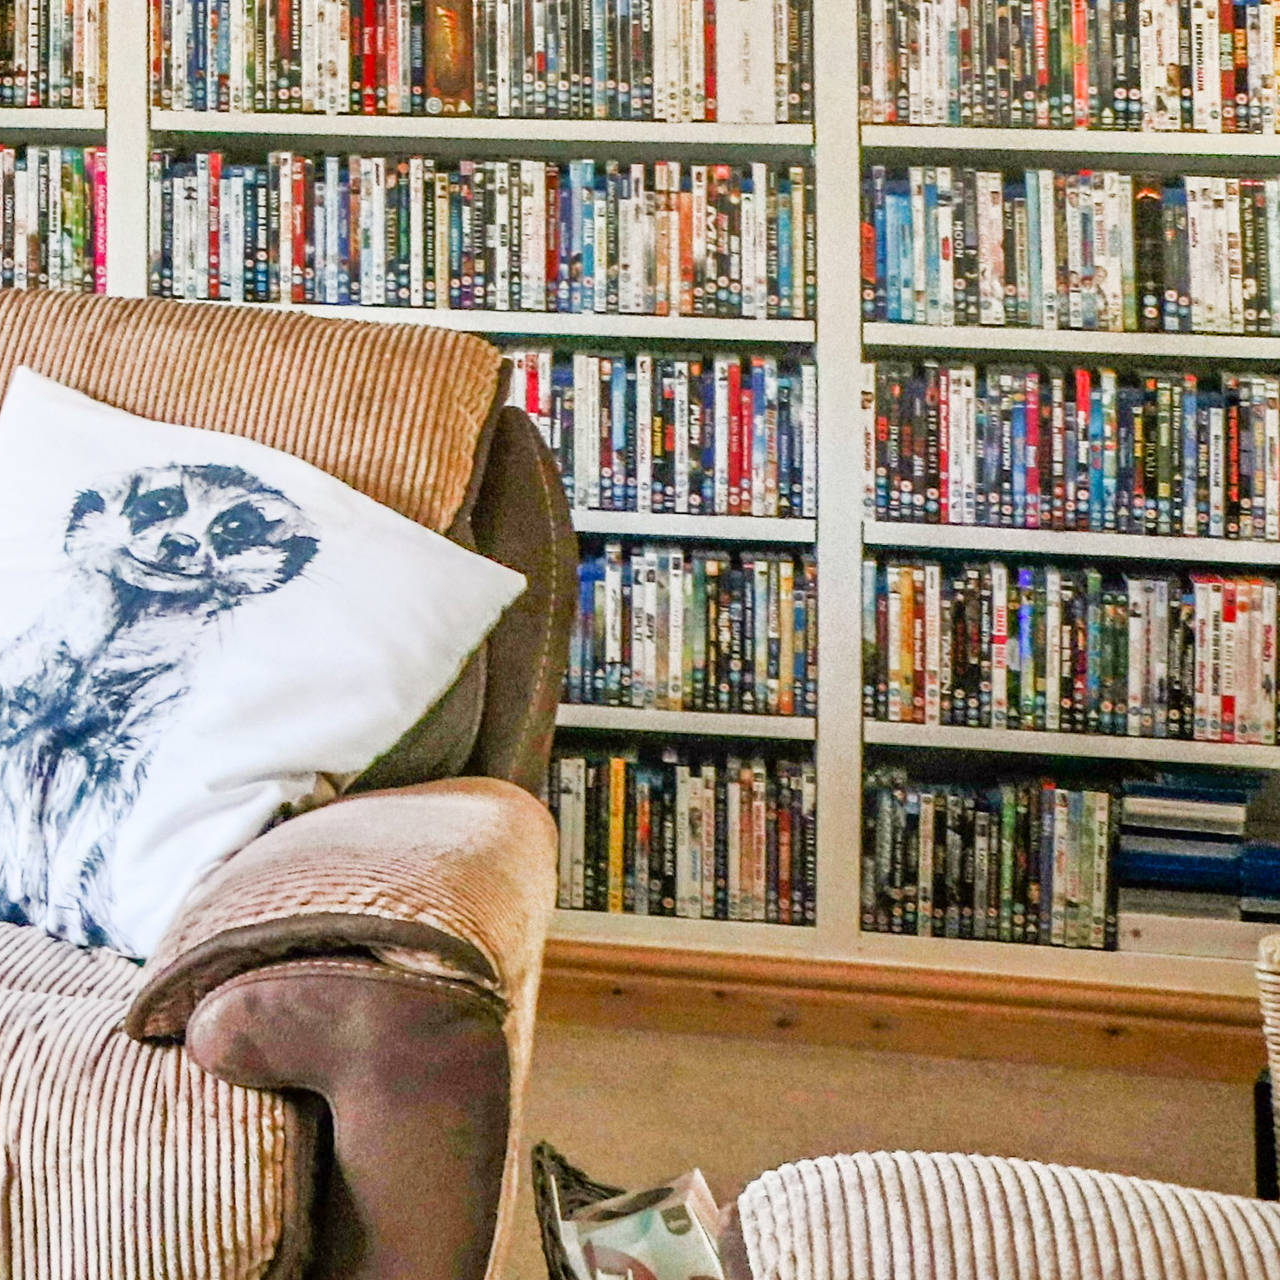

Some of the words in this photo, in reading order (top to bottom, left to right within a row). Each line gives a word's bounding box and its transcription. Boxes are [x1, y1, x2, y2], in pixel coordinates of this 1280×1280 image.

[5, 194, 13, 224] LOVELY
[387, 208, 396, 262] MATILDA
[584, 219, 593, 246] MILK
[954, 220, 965, 258] MOON
[768, 251, 777, 279] MIST
[689, 404, 700, 445] PUSH
[1002, 420, 1011, 471] RENDITION
[1144, 442, 1154, 477] ROAD
[634, 607, 643, 643] SPLIT
[646, 613, 655, 642] SPY
[941, 631, 951, 694] TAKEN
